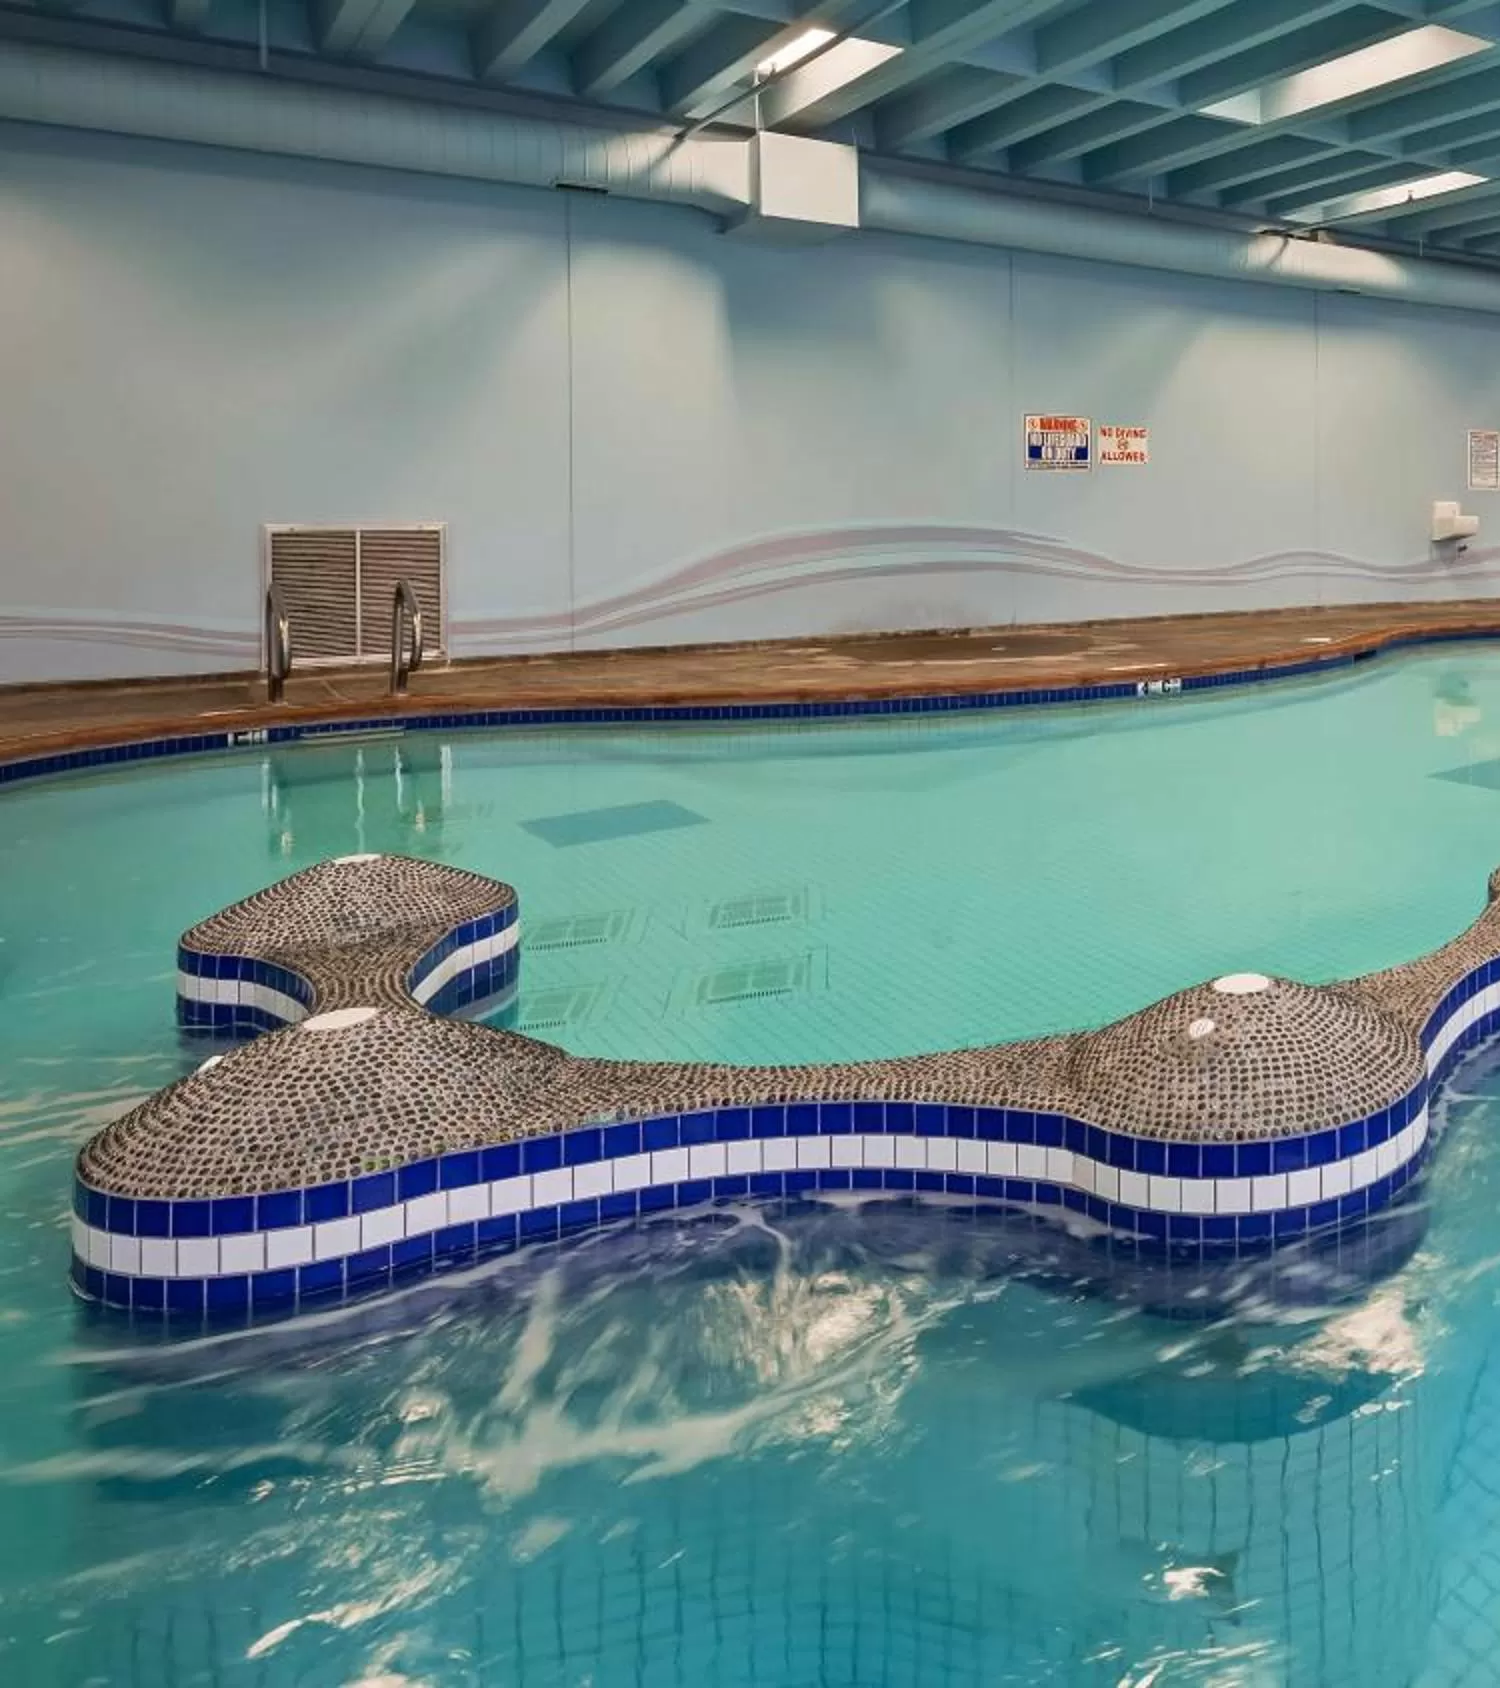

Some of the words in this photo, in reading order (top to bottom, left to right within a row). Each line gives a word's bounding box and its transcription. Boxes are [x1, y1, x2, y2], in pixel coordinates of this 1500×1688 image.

[1100, 427, 1112, 437] NO
[1115, 428, 1147, 438] DIVING
[1101, 451, 1145, 462] ALLOWED
